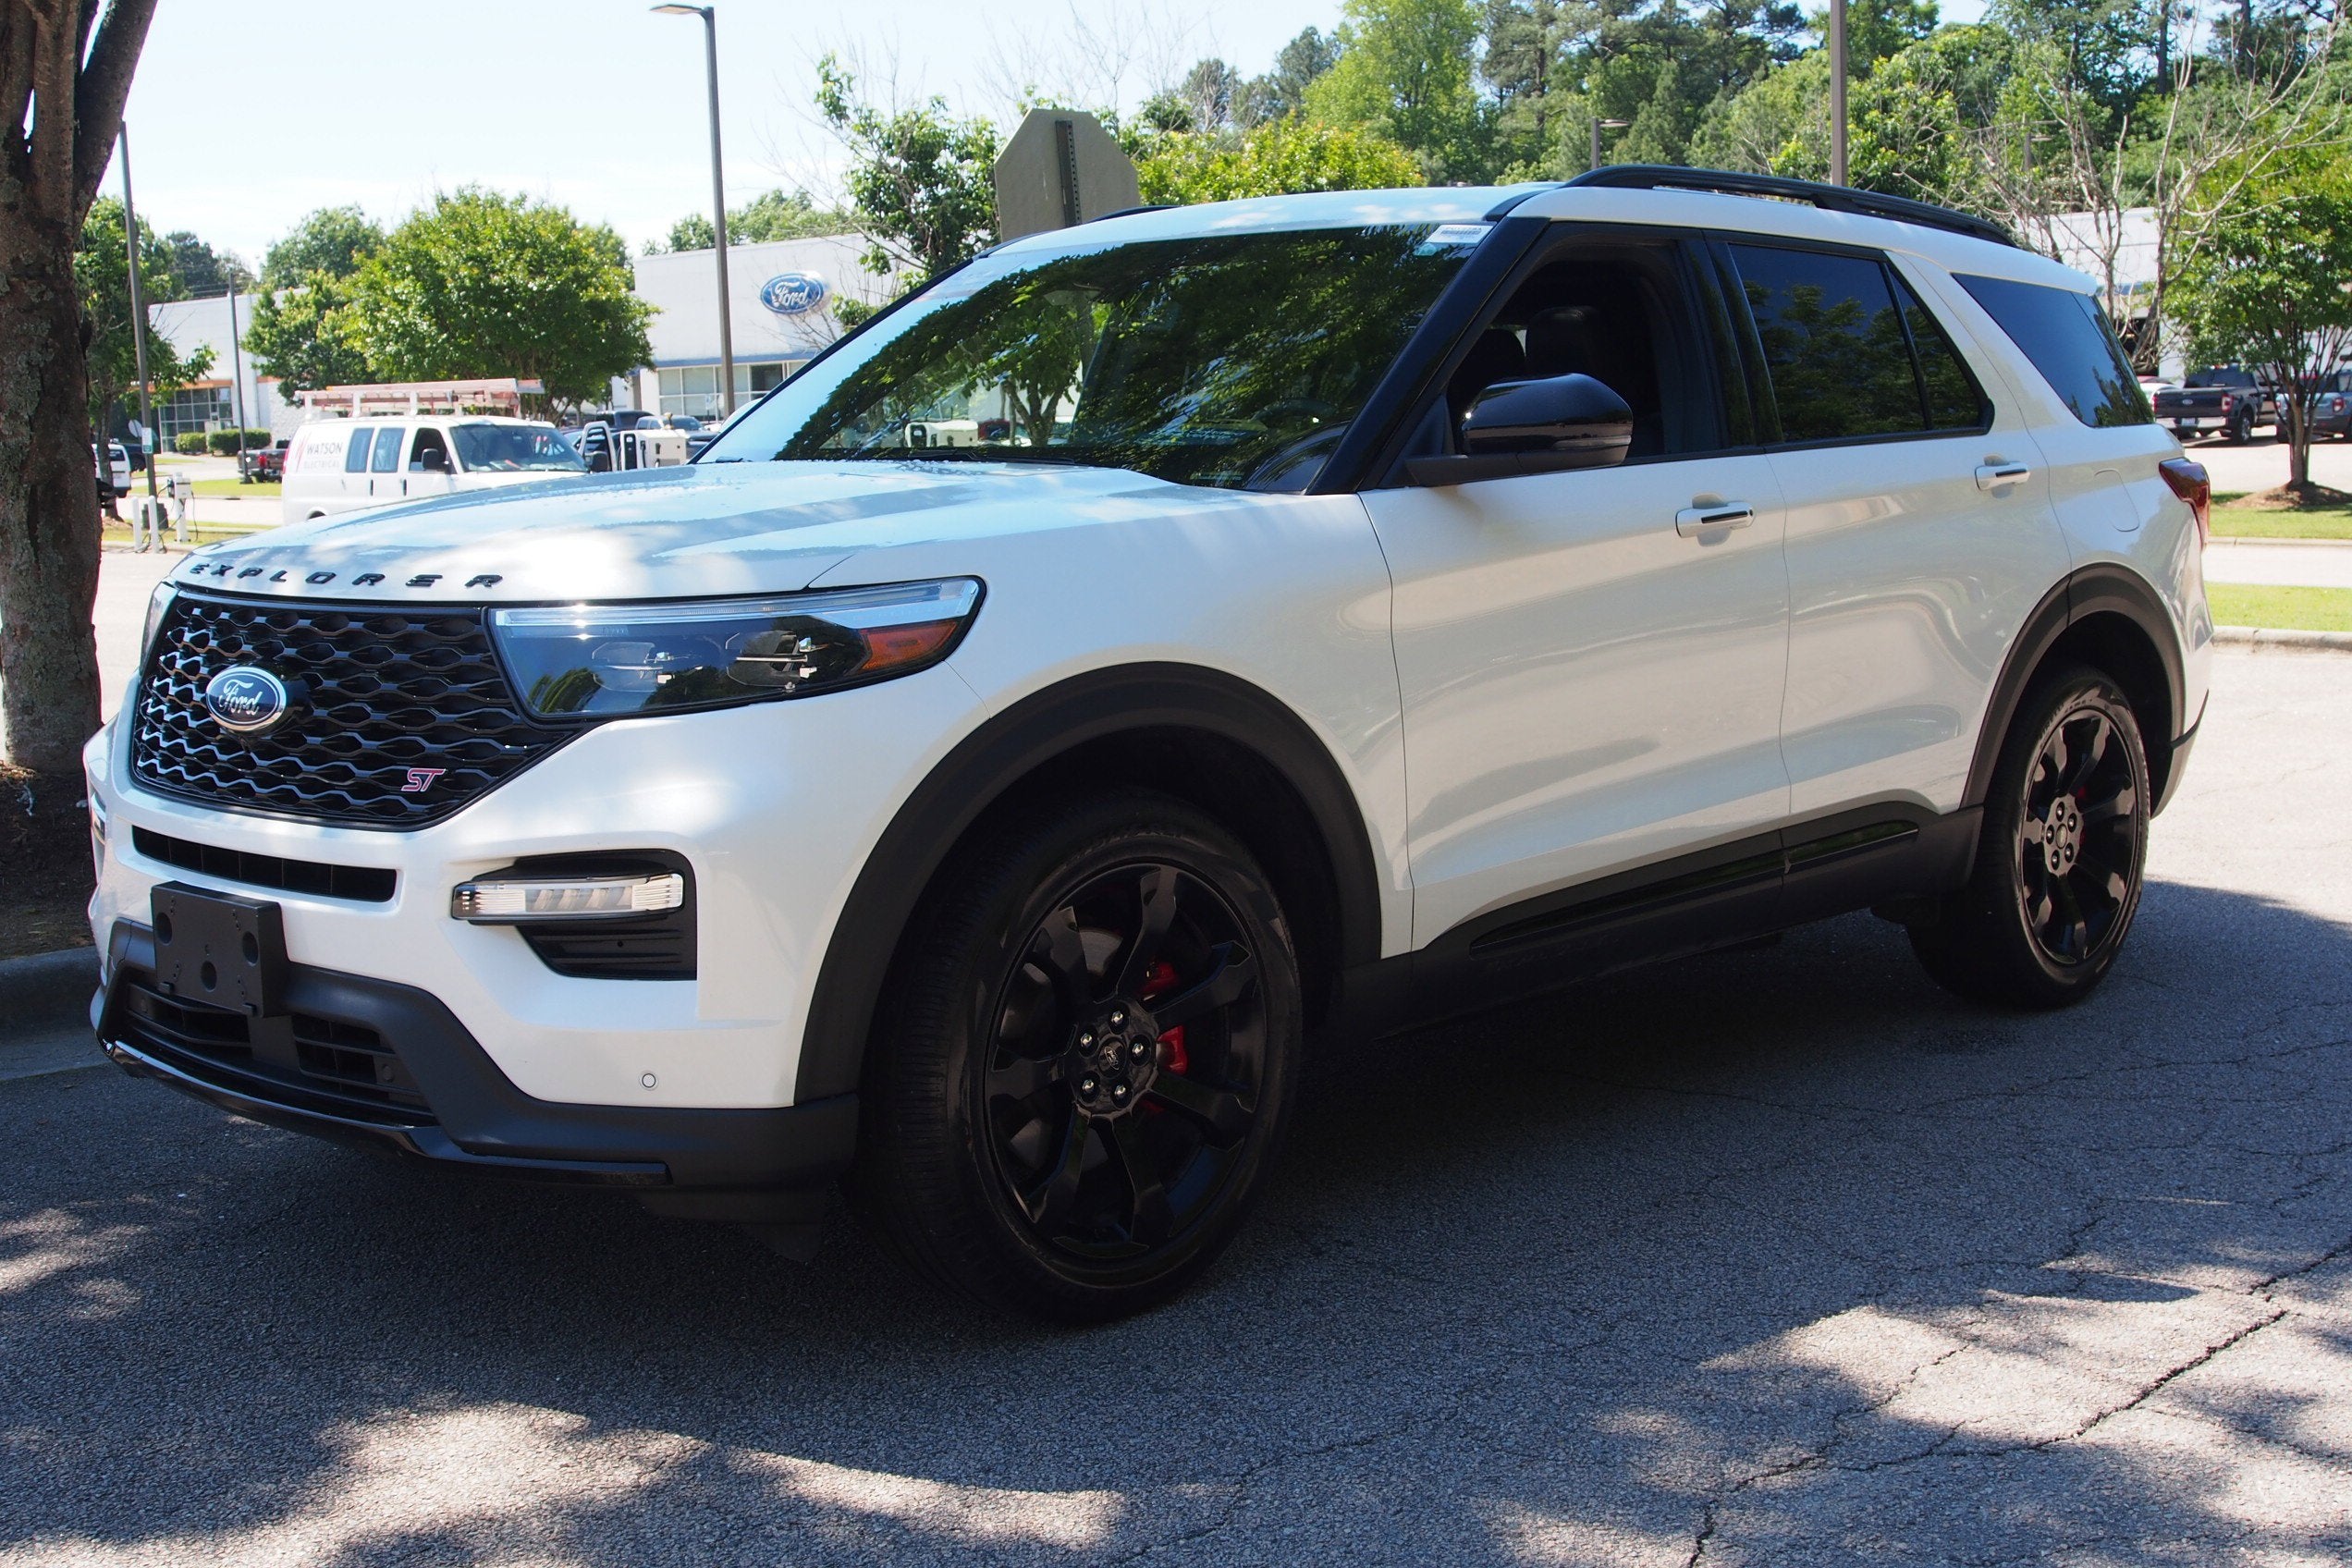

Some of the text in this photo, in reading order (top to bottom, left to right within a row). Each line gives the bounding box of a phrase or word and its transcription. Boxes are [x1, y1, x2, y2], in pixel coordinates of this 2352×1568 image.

[772, 281, 809, 308] Ford
[307, 442, 343, 455] WATSON
[190, 563, 503, 588] EXPLORER
[218, 679, 263, 716] Ford
[400, 767, 447, 792] ST
